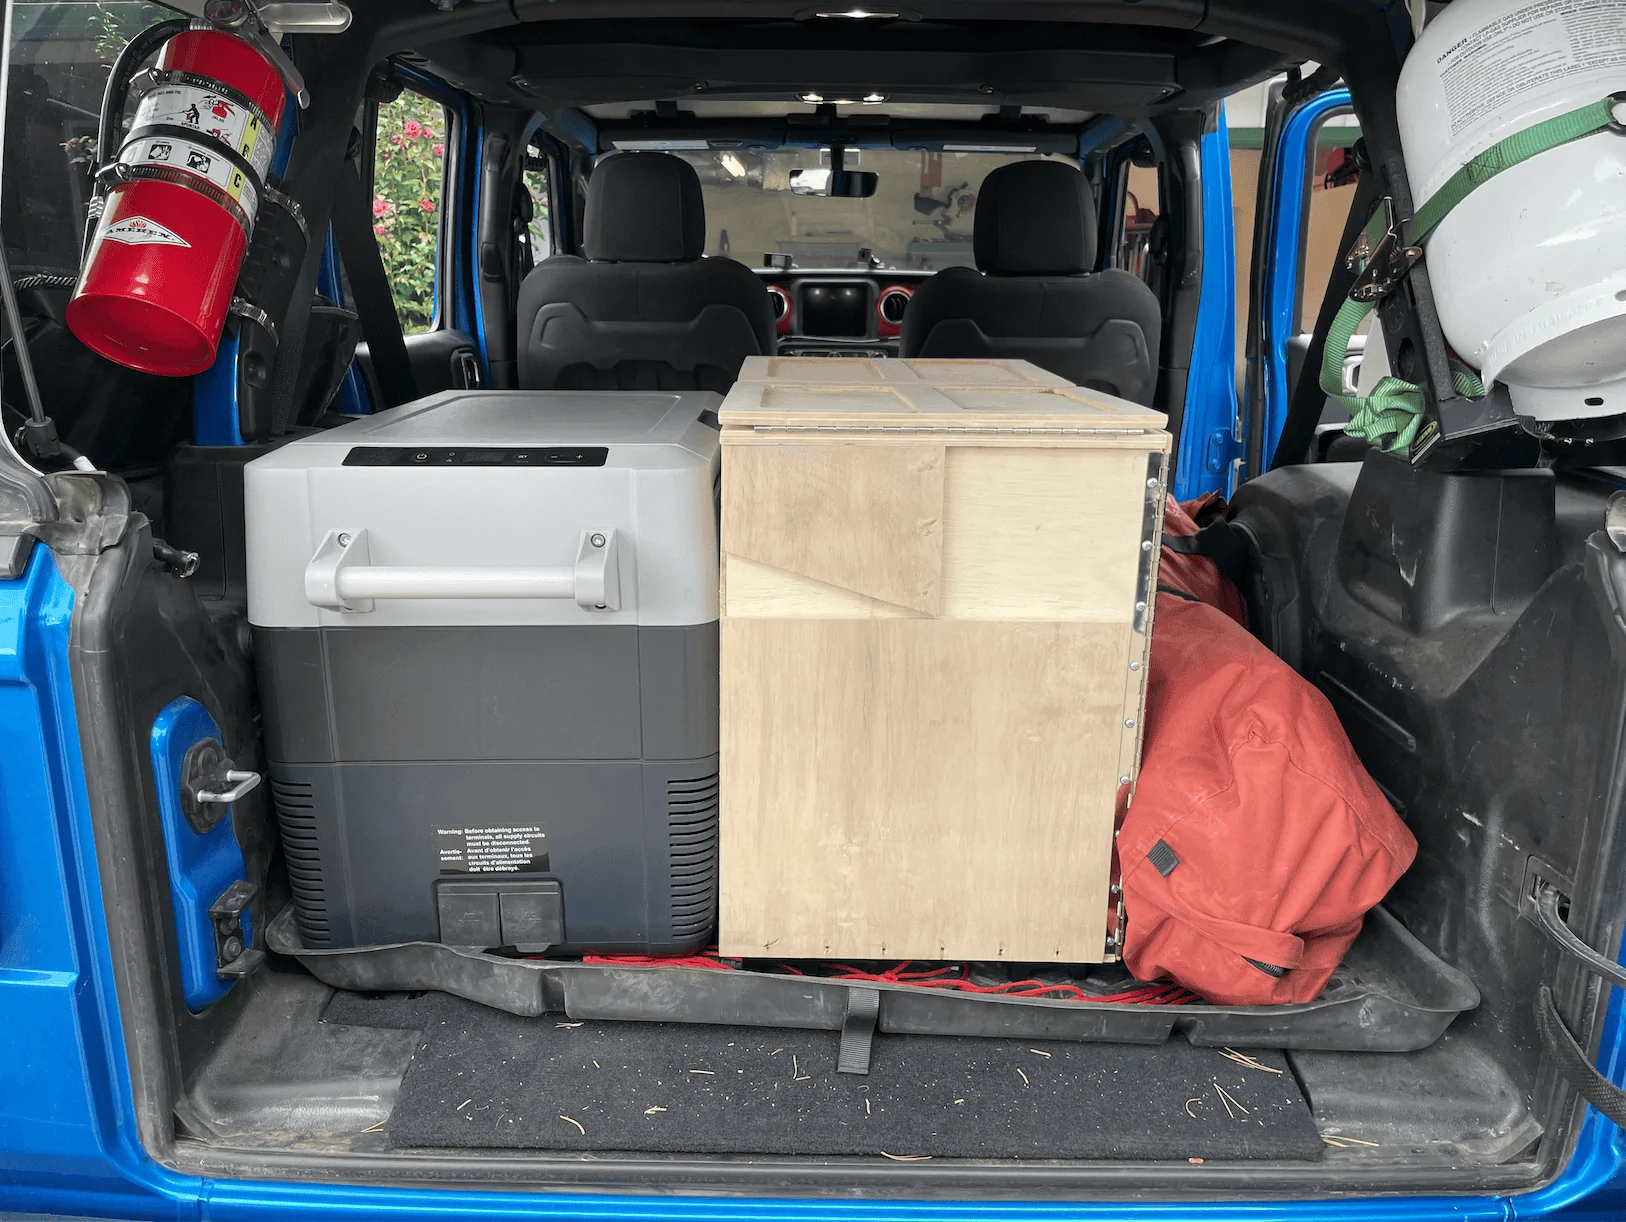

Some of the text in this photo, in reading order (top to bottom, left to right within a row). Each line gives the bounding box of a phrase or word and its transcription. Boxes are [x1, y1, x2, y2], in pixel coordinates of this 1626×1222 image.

[1437, 38, 1468, 64] DANGER
[1472, 20, 1502, 38] FLAMMABLE
[1503, 13, 1514, 21] GAS
[1514, 5, 1533, 16] UNDER
[1460, 40, 1483, 59] OUTDOOR
[1483, 35, 1493, 44] USE
[1521, 16, 1532, 24] NOT
[1555, 5, 1573, 13] STORE
[1461, 34, 1482, 51] CONTACT
[1501, 14, 1527, 27] SUPPLIER
[1539, 1, 1563, 12] REPAIRS
[1516, 72, 1549, 90] OBLITERATE
[250, 117, 258, 131] A
[234, 173, 241, 188] C
[105, 227, 171, 239] AMEREX
